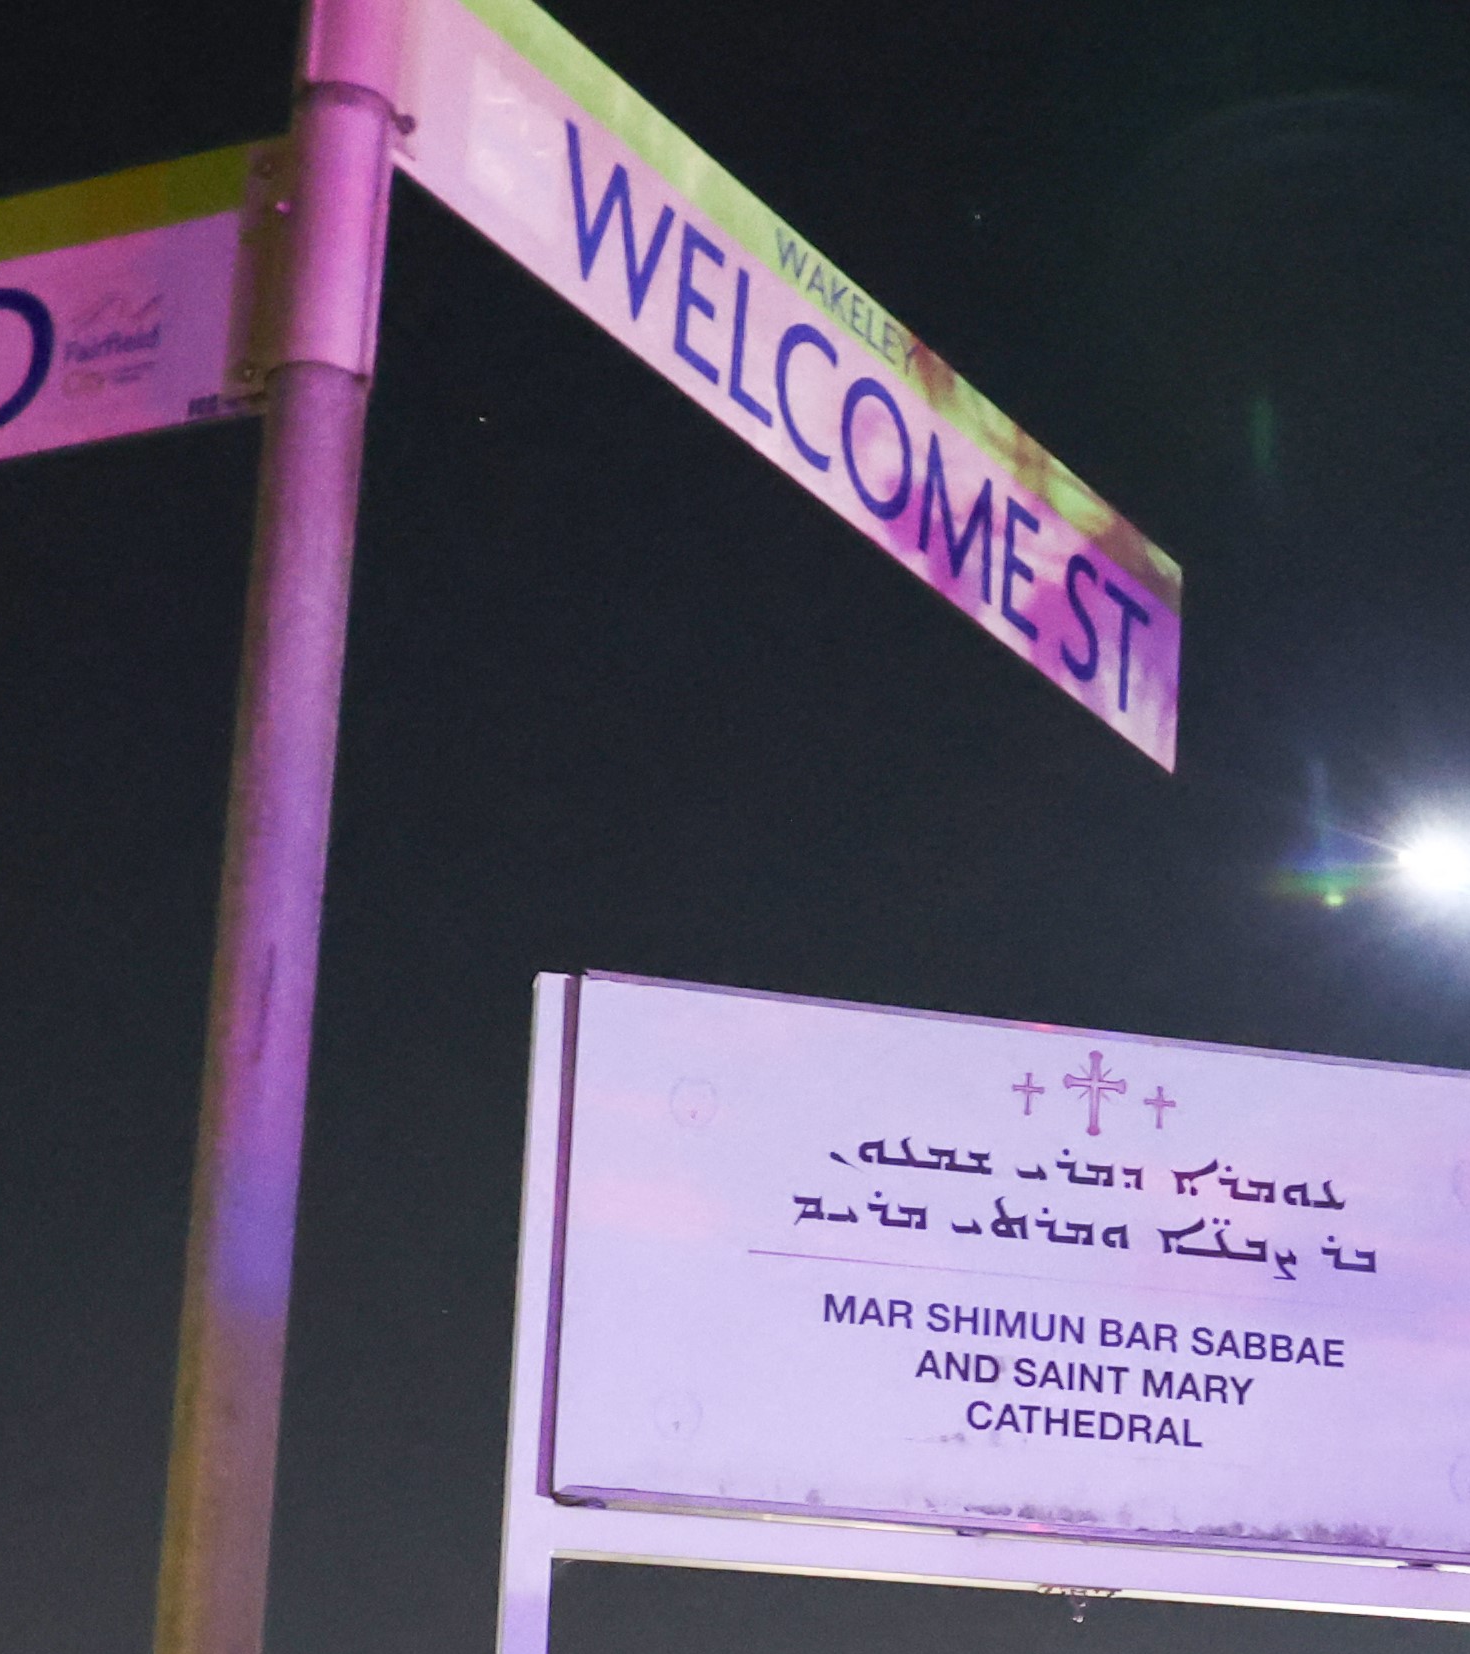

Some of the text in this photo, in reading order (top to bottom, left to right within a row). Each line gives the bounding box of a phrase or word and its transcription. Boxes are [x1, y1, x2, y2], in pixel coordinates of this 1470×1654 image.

[777, 233, 919, 376] WAKELEY
[566, 120, 1150, 713] WELCOME ST
[824, 1293, 1345, 1368] MAR SHIMUN BAR SABBAE
[915, 1349, 1255, 1405] AND SAINT MARY
[966, 1400, 1203, 1448] CATHEDRAL
